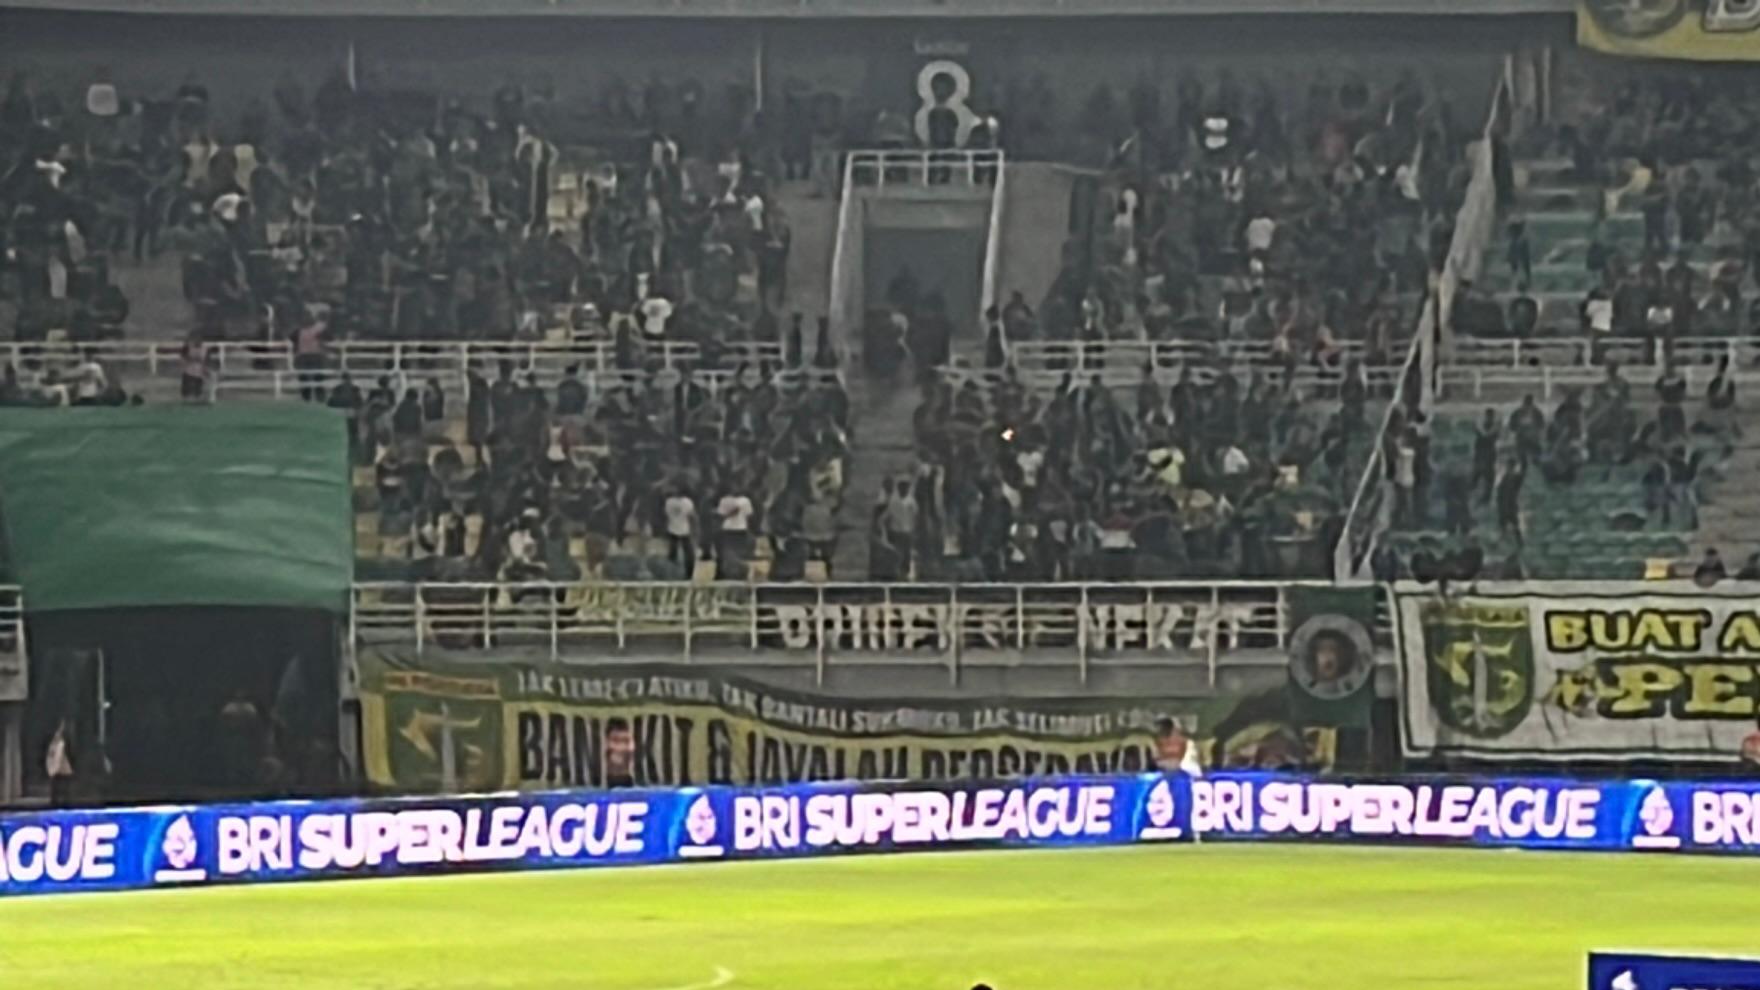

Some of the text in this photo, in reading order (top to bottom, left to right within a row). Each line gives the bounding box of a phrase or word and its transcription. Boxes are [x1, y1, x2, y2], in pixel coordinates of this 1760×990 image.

[914, 59, 974, 148] 8
[1545, 608, 1710, 652] BUAT
[518, 709, 694, 786] BANKIT
[733, 794, 799, 850] BRI
[1192, 780, 1253, 832] BRI
[218, 815, 293, 874] BRI
